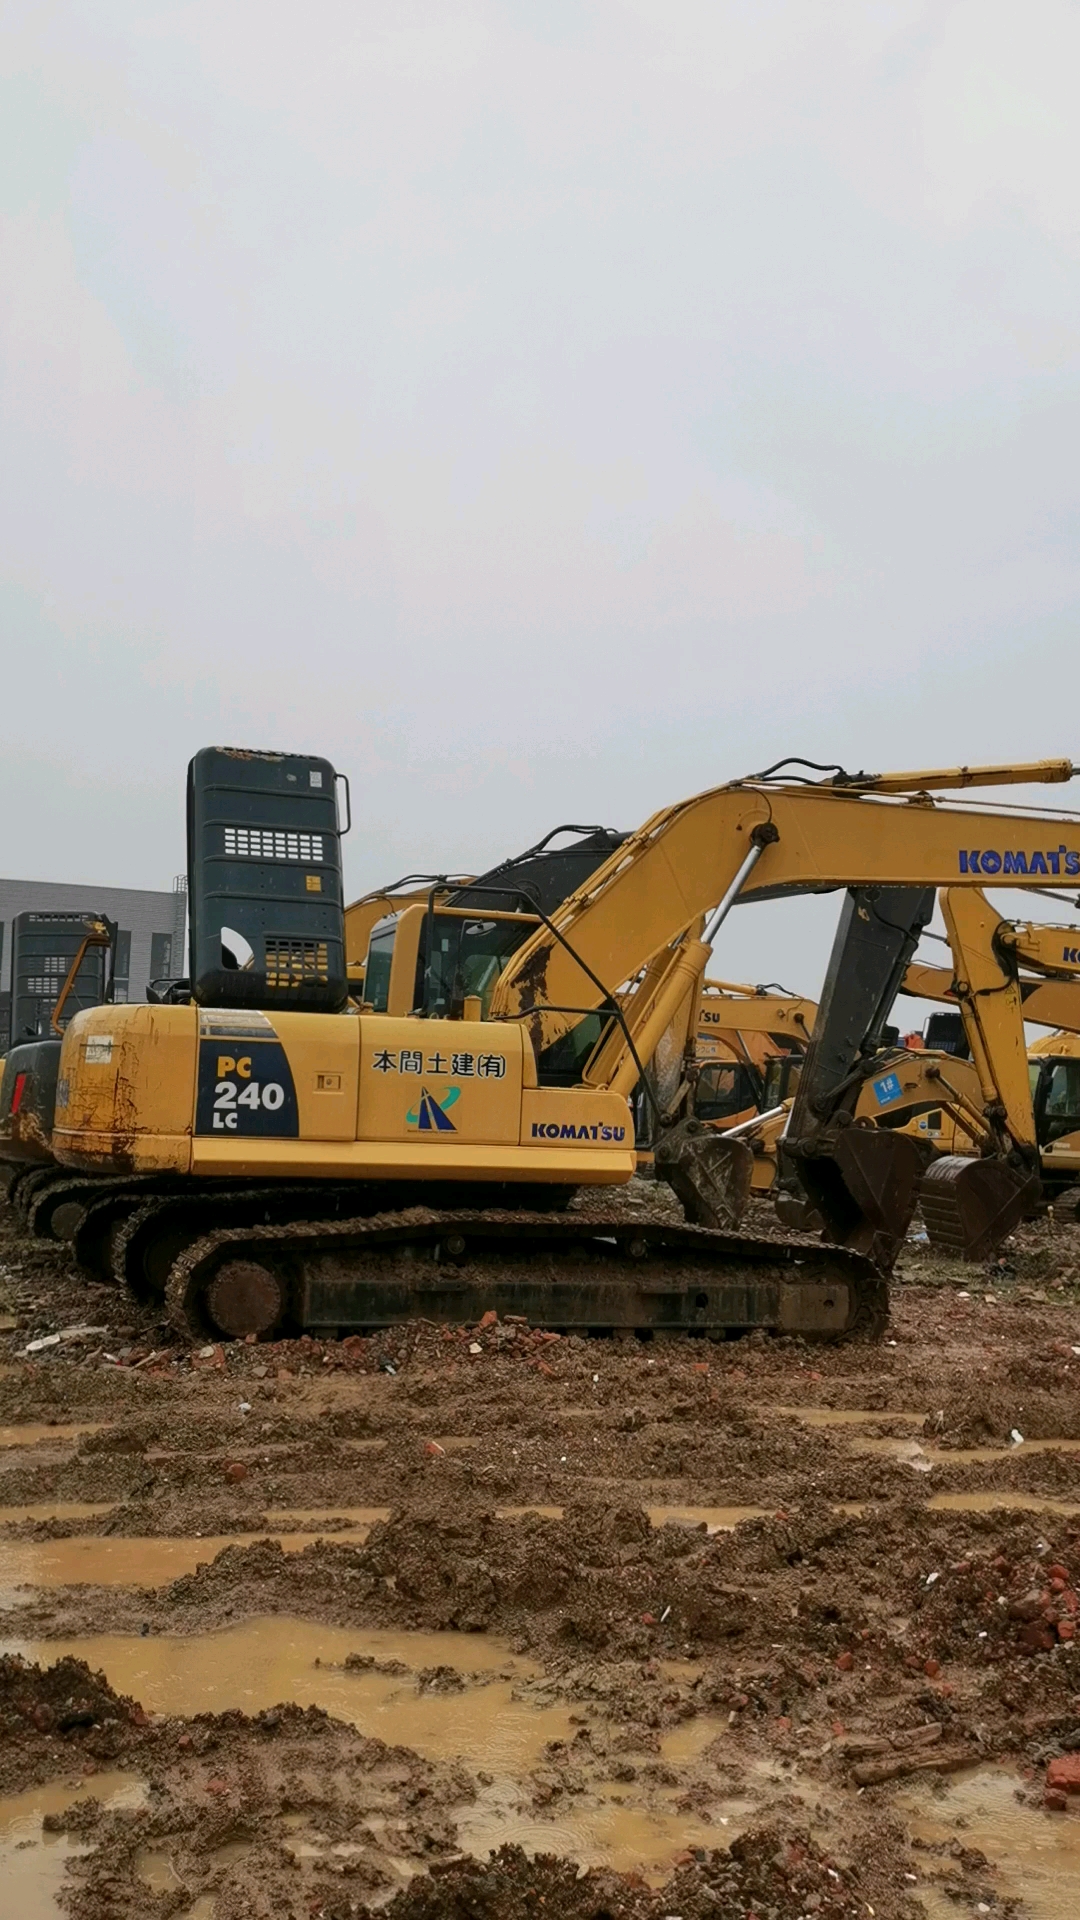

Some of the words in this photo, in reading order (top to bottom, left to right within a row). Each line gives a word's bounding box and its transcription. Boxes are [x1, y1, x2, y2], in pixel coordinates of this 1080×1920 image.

[217, 1056, 252, 1078] PC
[372, 1049, 506, 1078] 本間土建(有)
[213, 1081, 285, 1110] 240
[212, 1112, 238, 1129] LC
[531, 1121, 625, 1141] KOMATSU
